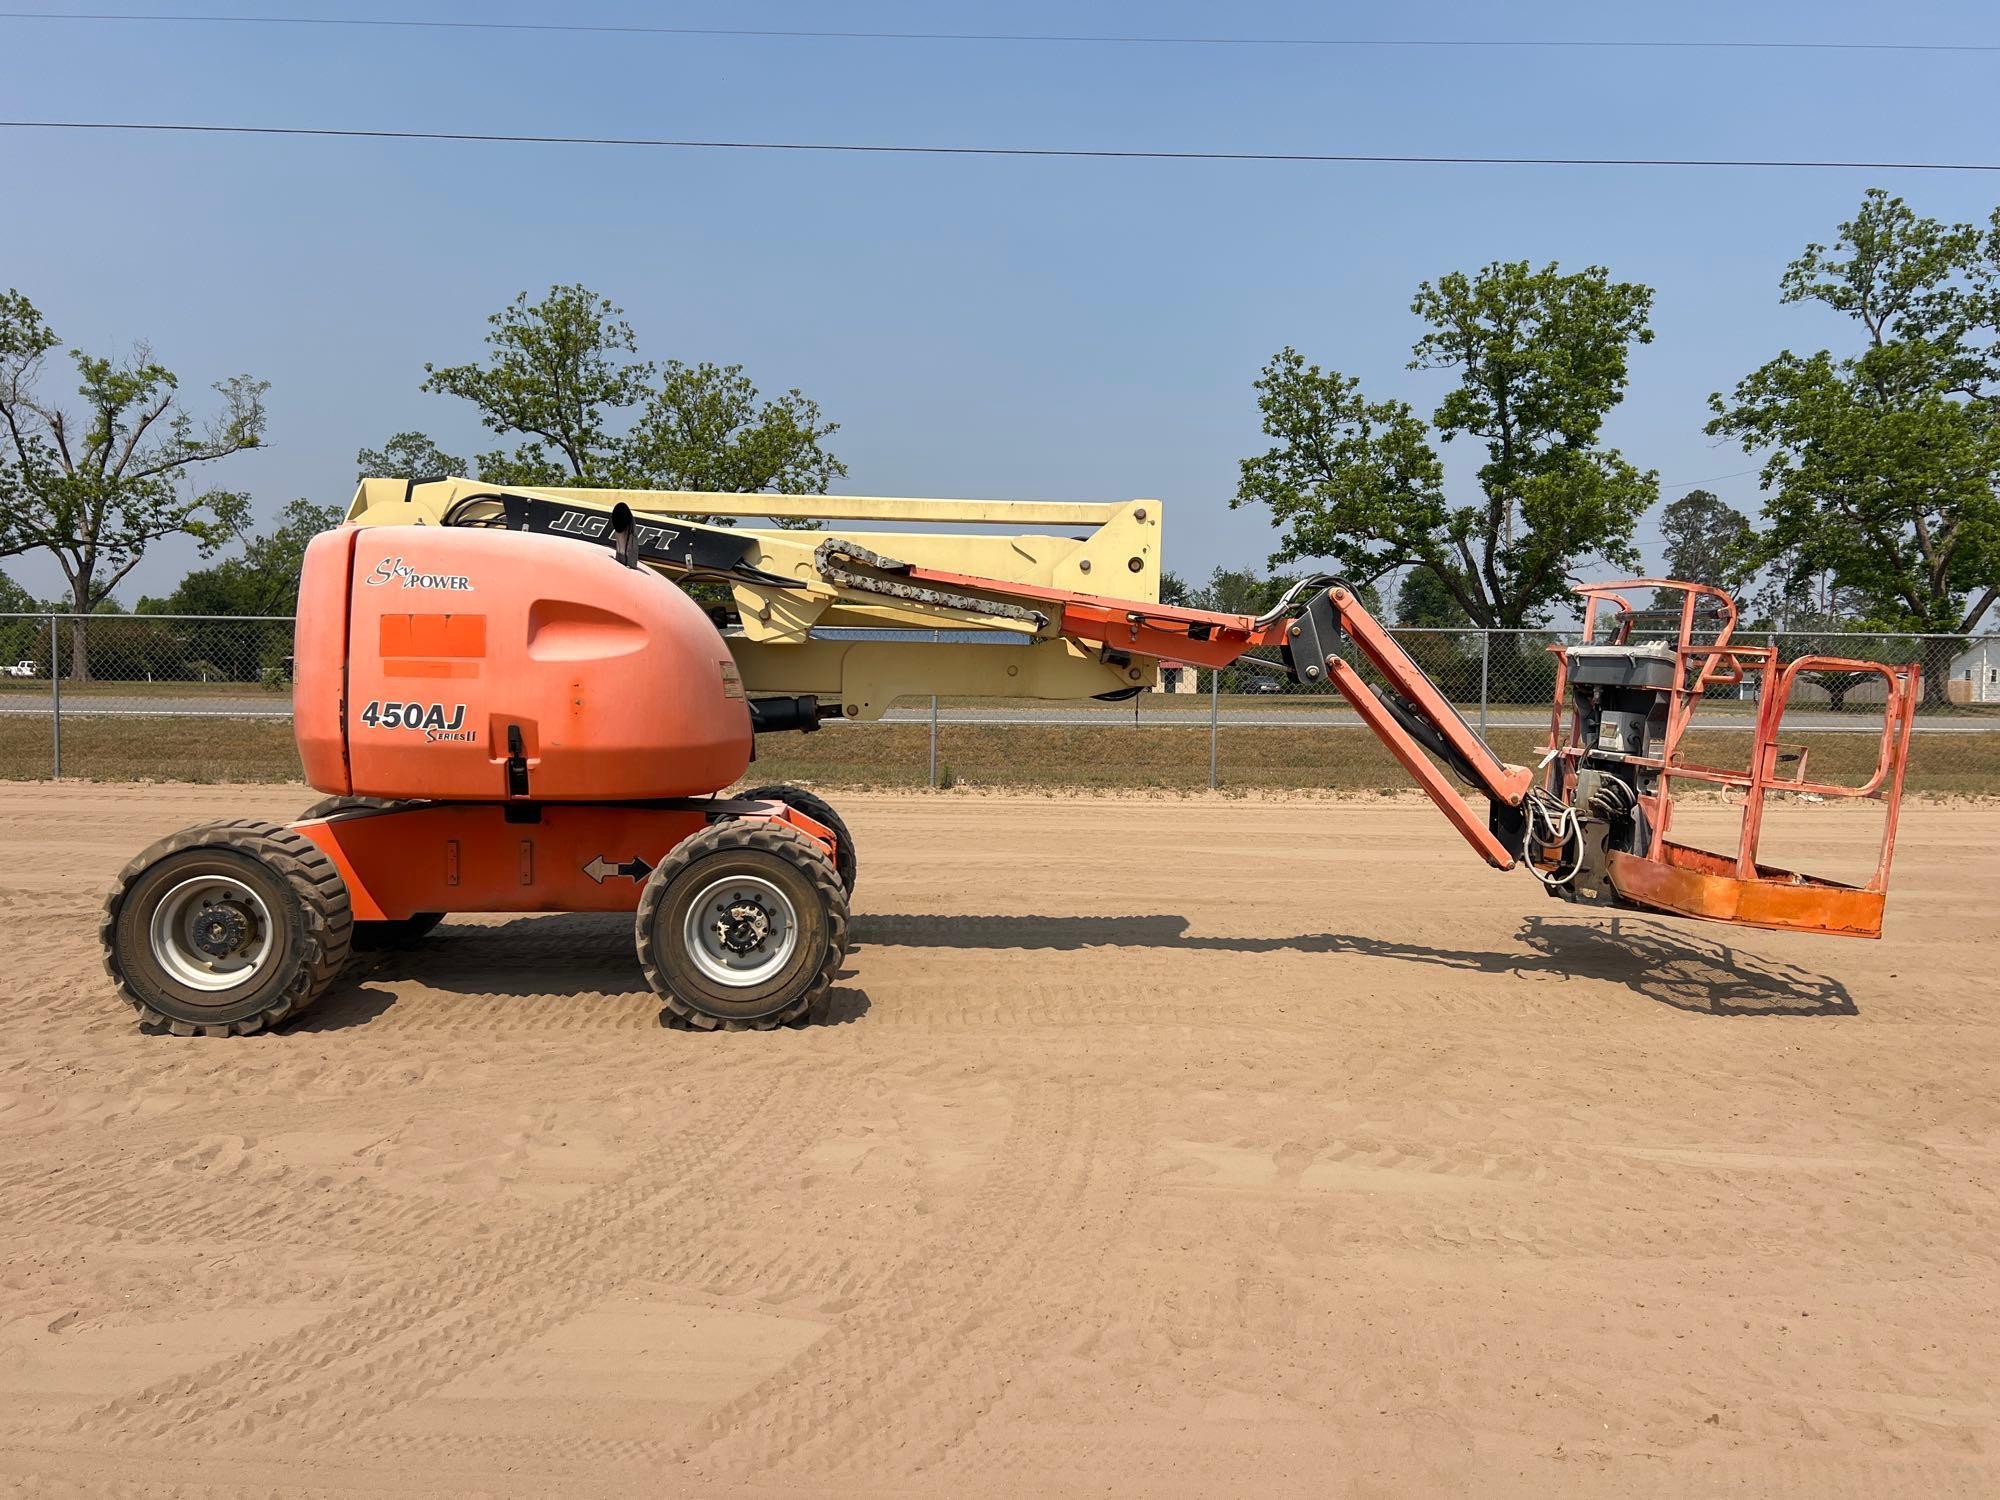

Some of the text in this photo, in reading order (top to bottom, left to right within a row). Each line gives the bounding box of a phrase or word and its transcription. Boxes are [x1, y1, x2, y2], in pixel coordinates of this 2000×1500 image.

[549, 511, 680, 550] JLG FT
[361, 701, 466, 730] 450AJ
